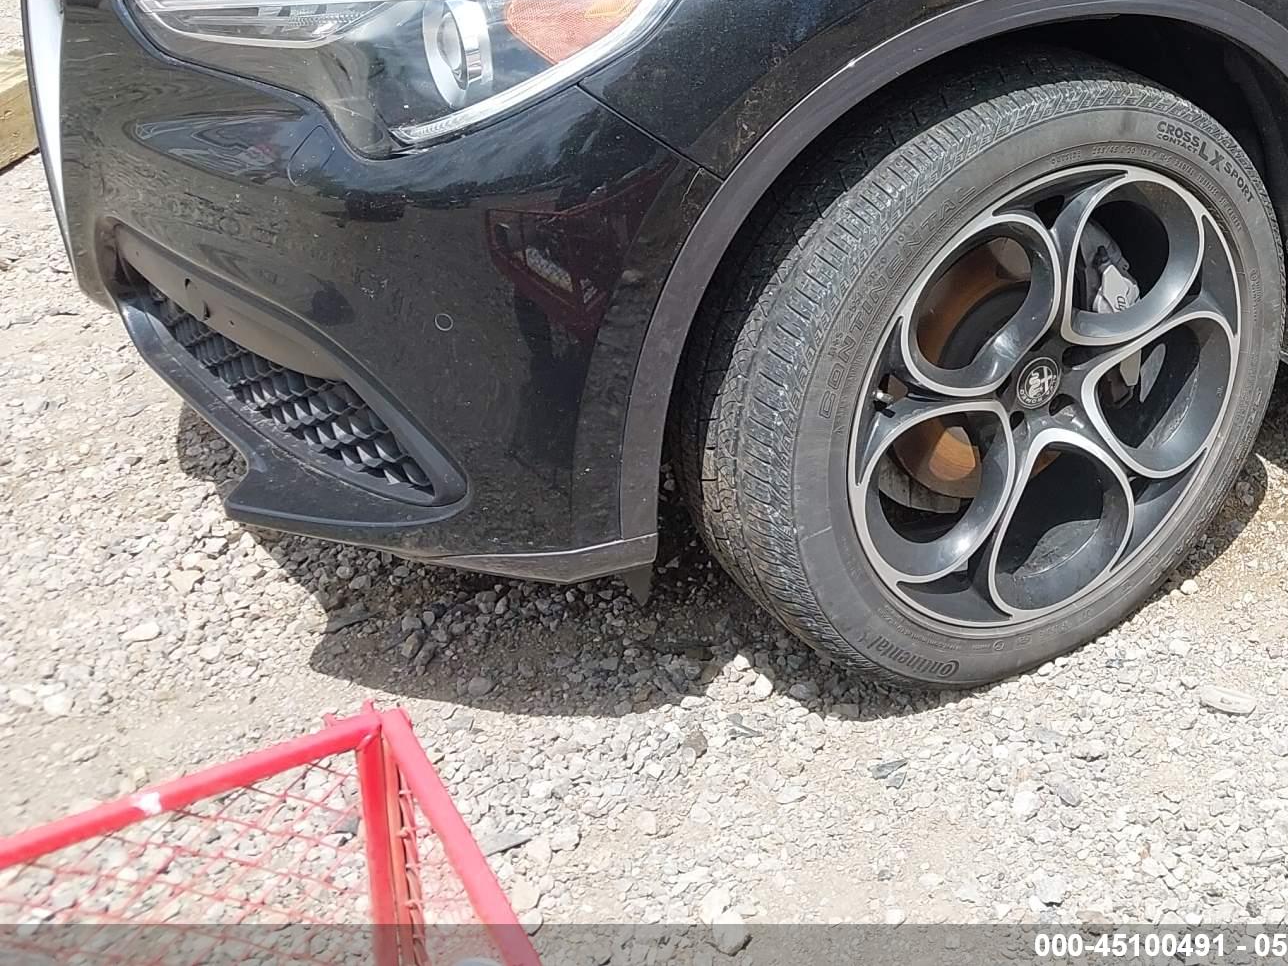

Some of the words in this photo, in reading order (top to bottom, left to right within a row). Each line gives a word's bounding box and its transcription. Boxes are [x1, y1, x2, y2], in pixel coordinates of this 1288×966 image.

[1156, 120, 1201, 148] CROSS
[1156, 132, 1199, 155] CONTACT
[1198, 140, 1225, 173] LX
[1223, 161, 1255, 203] SPORT
[818, 185, 978, 420] CONTINENTAL
[866, 634, 960, 679] Continental
